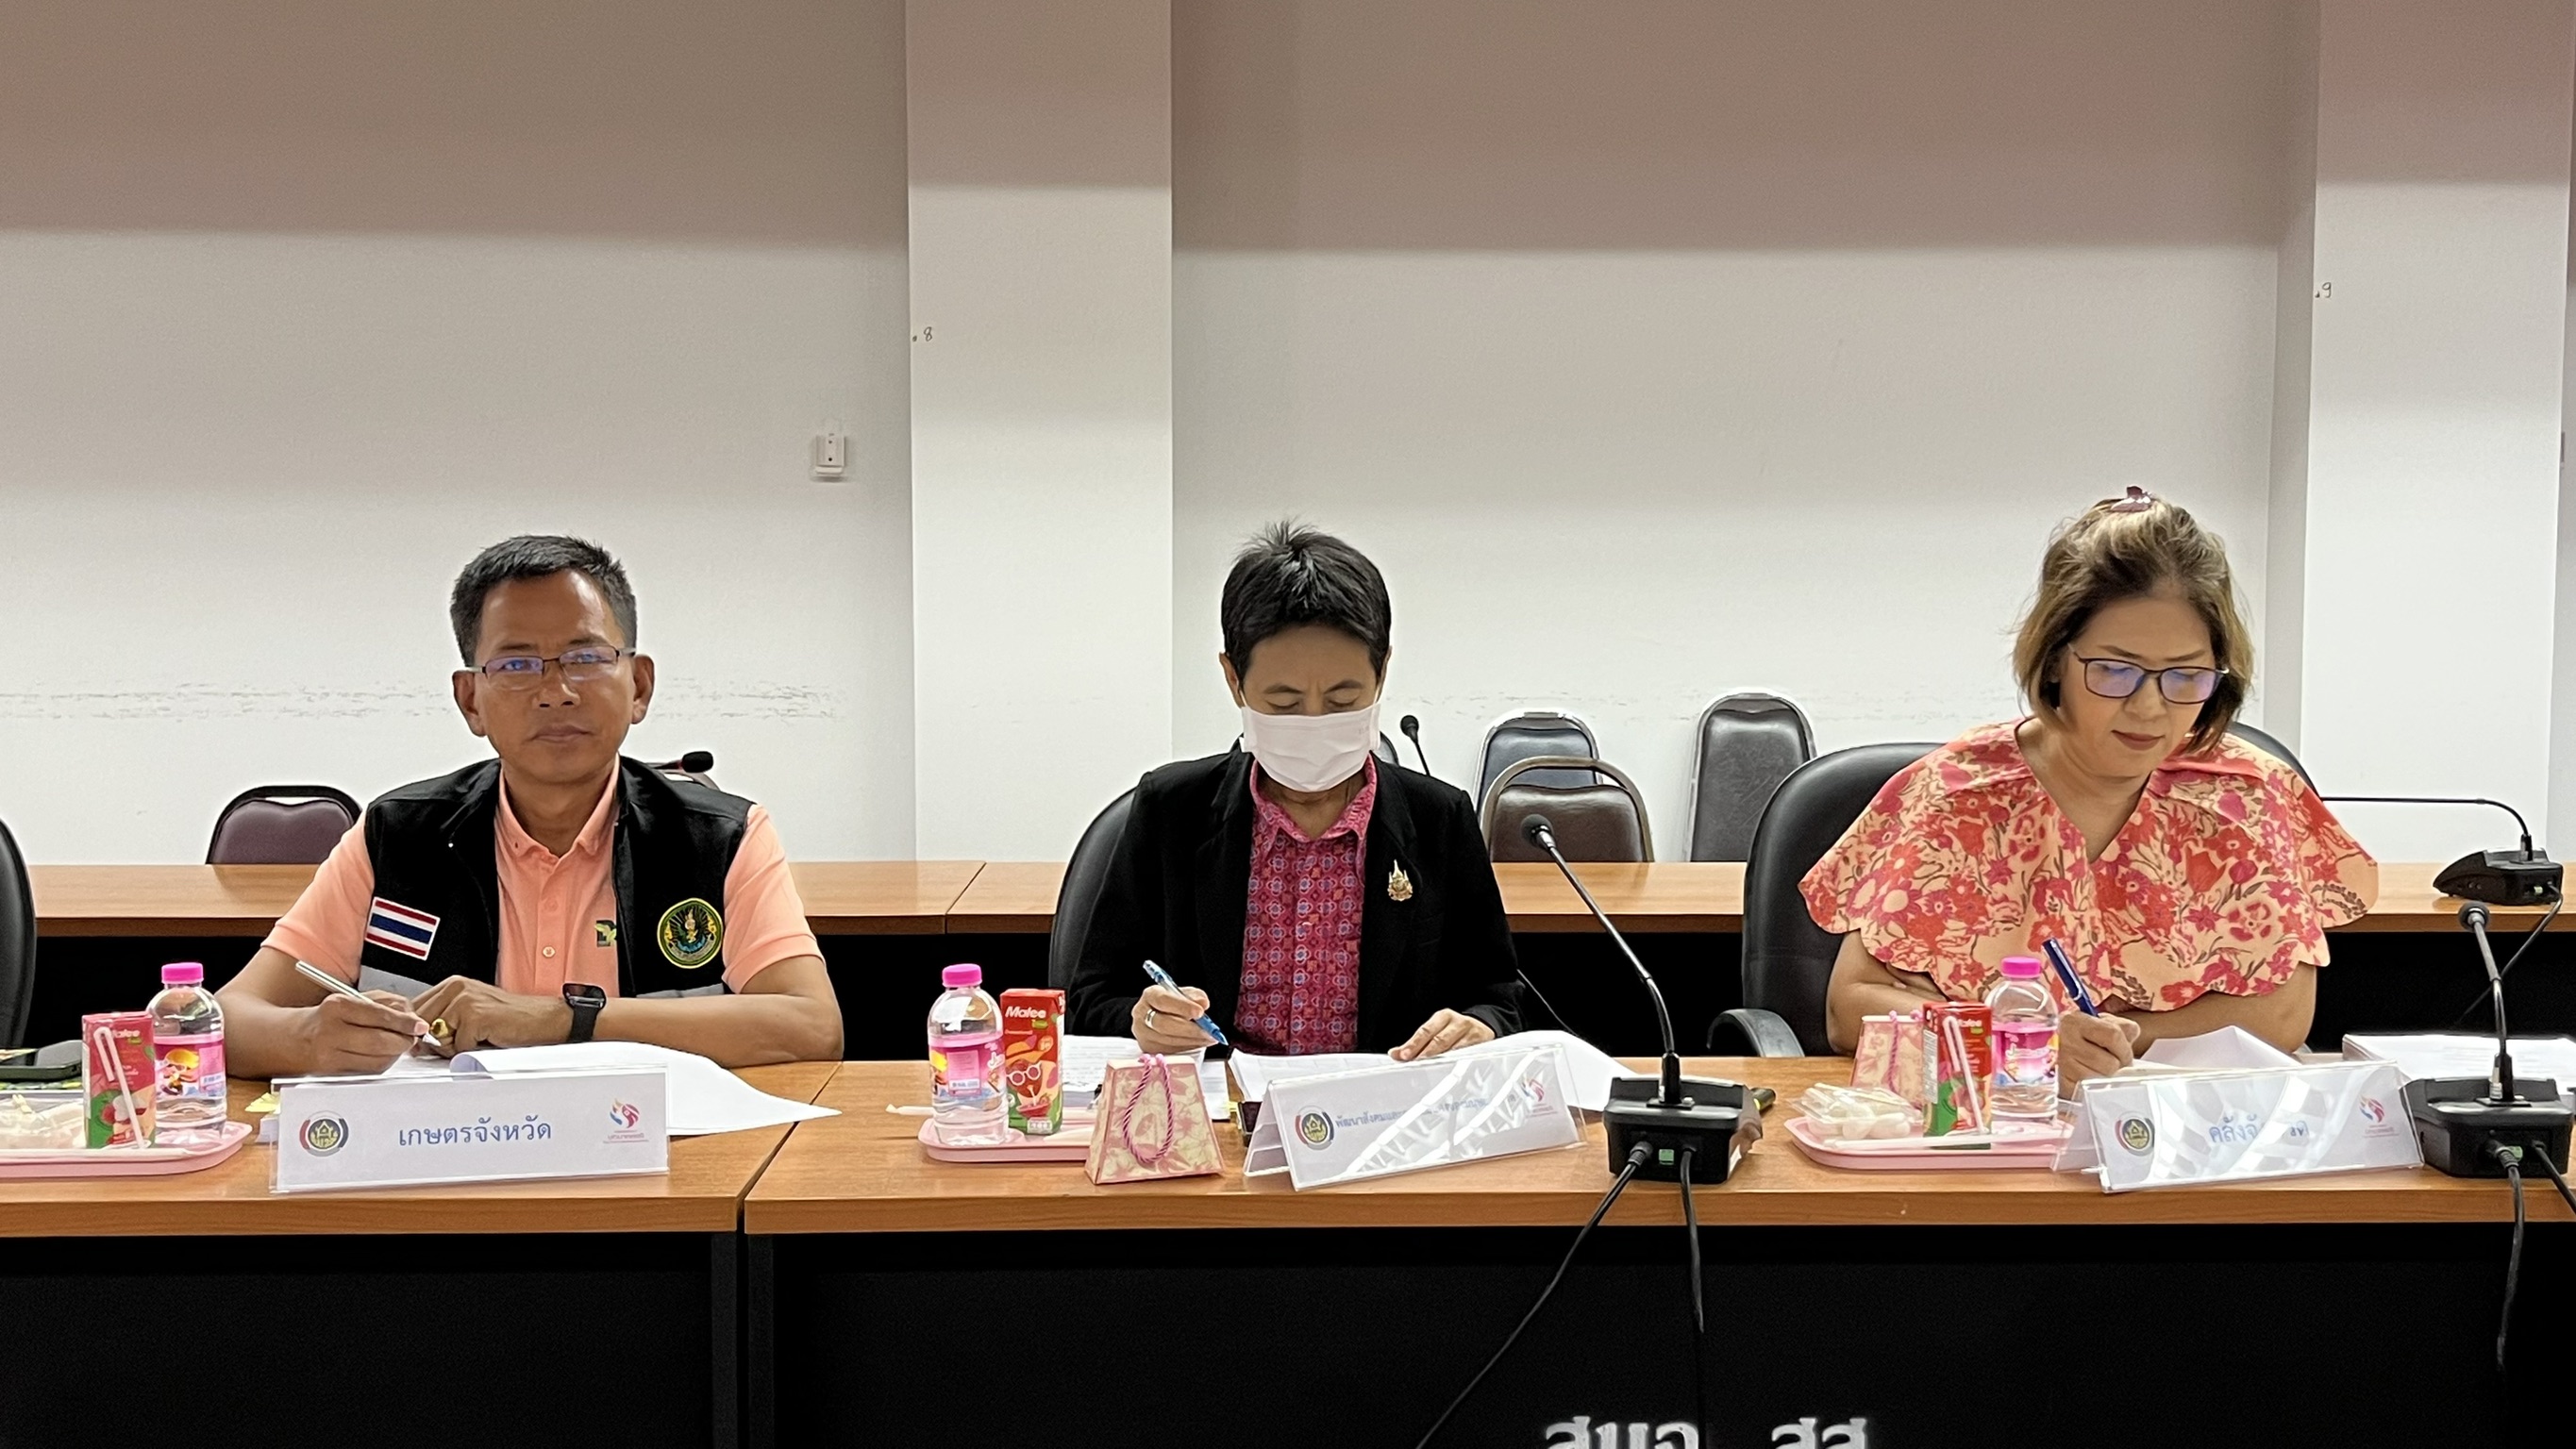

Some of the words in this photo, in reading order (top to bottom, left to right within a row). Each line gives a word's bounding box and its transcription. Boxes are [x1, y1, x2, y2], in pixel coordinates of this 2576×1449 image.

[1005, 1006, 1046, 1019] Malee
[398, 1114, 552, 1146] เกษตรจังหวัด
